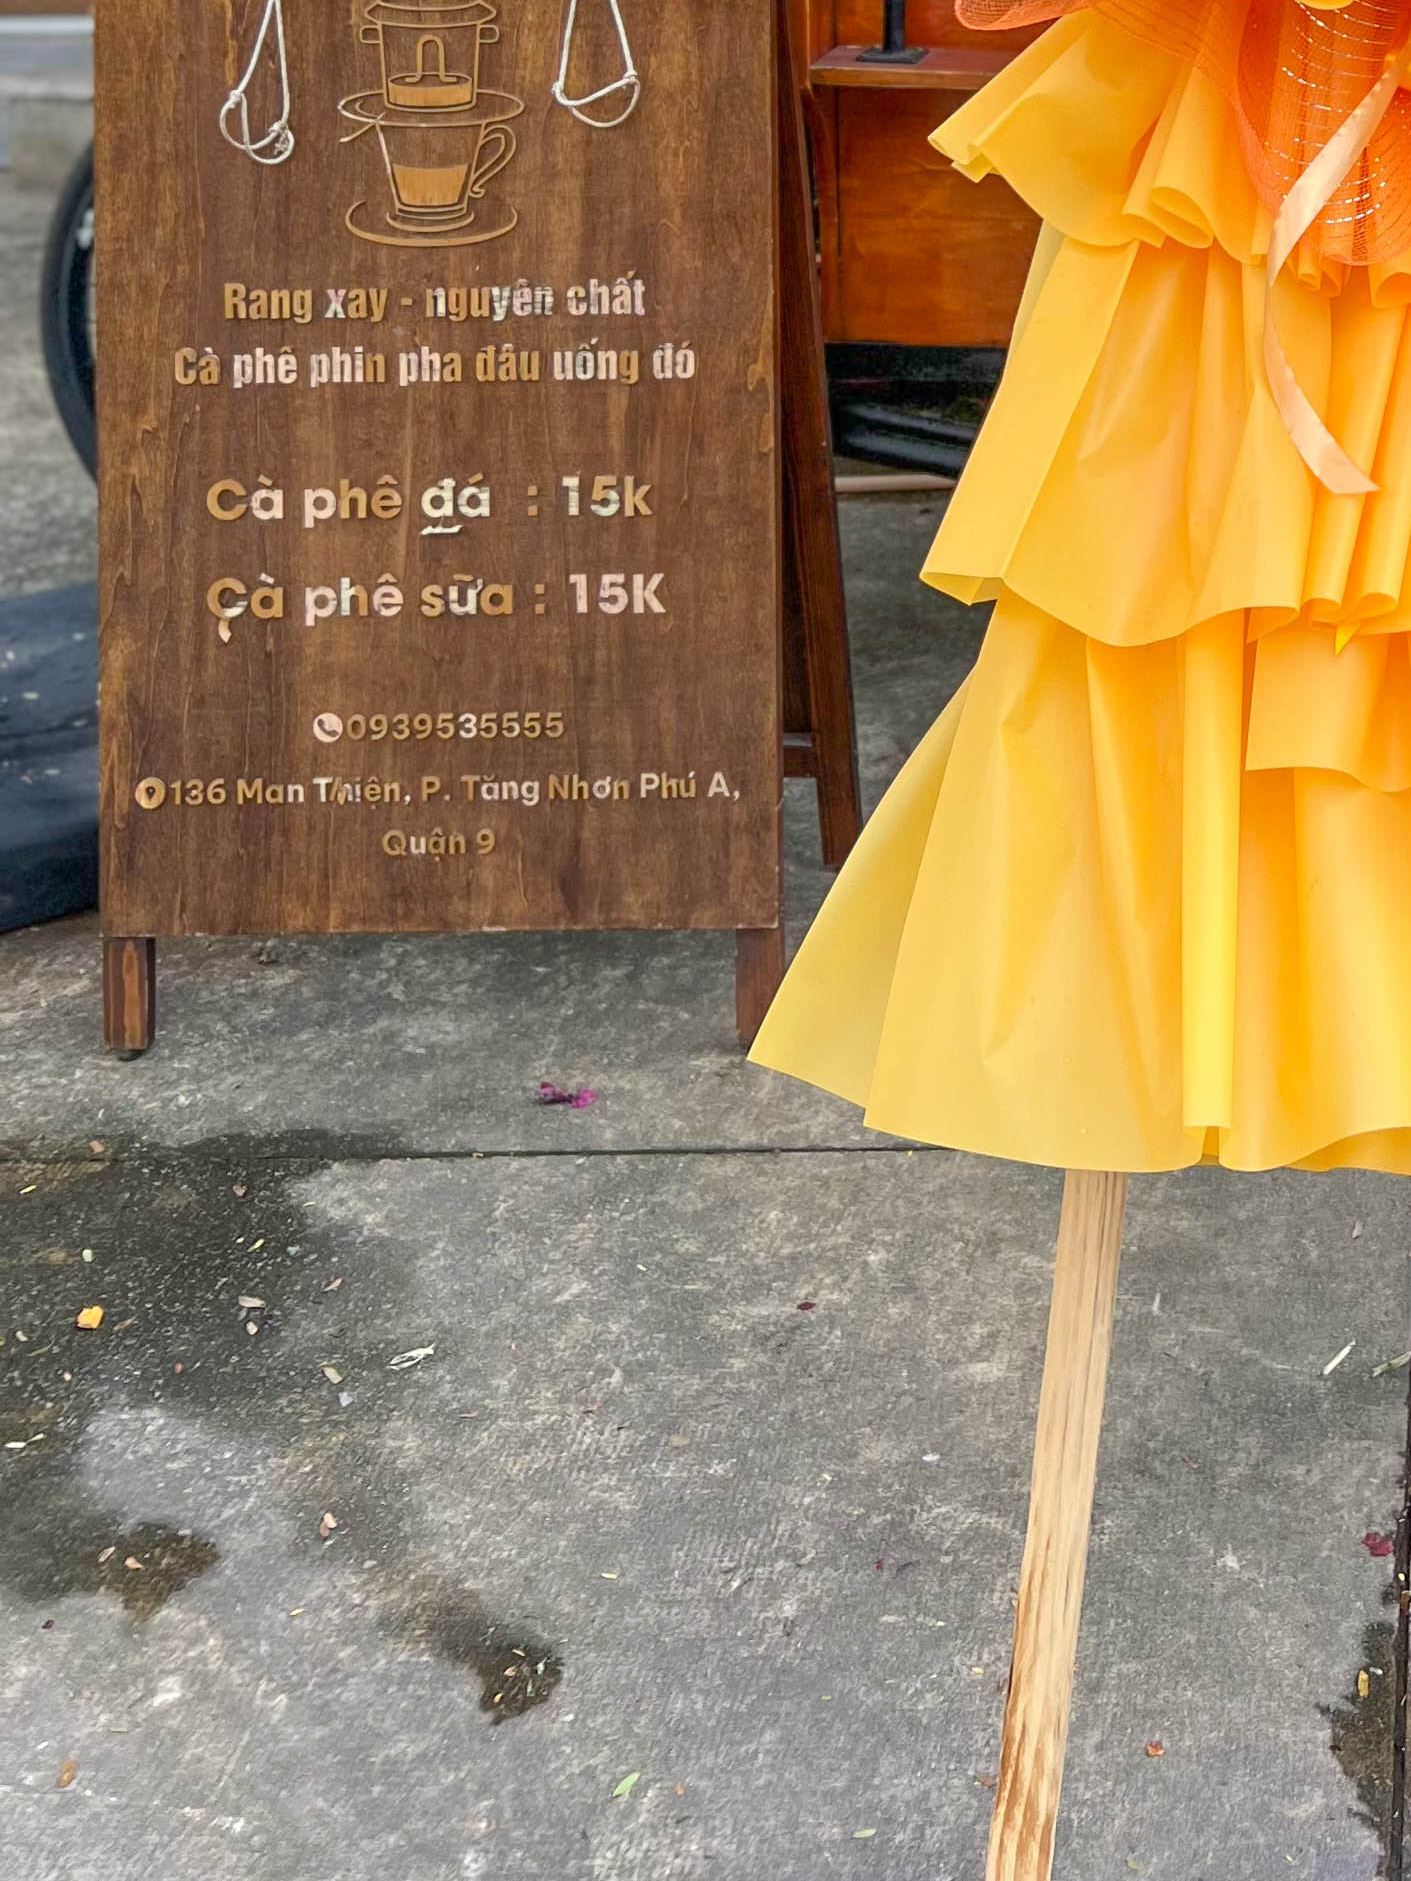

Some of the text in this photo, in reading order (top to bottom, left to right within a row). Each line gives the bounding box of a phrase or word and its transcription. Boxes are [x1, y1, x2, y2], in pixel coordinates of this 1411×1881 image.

[224, 282, 312, 323] Rang
[324, 287, 388, 322] xay
[426, 279, 554, 322] nguyên
[566, 271, 646, 317] chất
[174, 347, 221, 386] Cà
[233, 344, 298, 389] phê
[310, 346, 386, 388] phin
[399, 346, 463, 387] pha
[553, 338, 640, 385] uống
[652, 340, 696, 380] đó
[206, 474, 284, 521] Cà
[304, 475, 402, 528] phê
[420, 473, 491, 527] đá
[562, 472, 653, 518] 15k
[305, 573, 404, 626] phê
[420, 573, 514, 618] sữa
[569, 572, 667, 615] 15K
[347, 712, 565, 741] 0939535555
[170, 778, 227, 806] 136
[237, 778, 305, 805] Man
[461, 775, 541, 808] Tăng
[549, 774, 630, 801] Nhơn
[640, 771, 697, 800] Phú
[708, 771, 741, 801] A,
[382, 827, 496, 862] Quận 9
